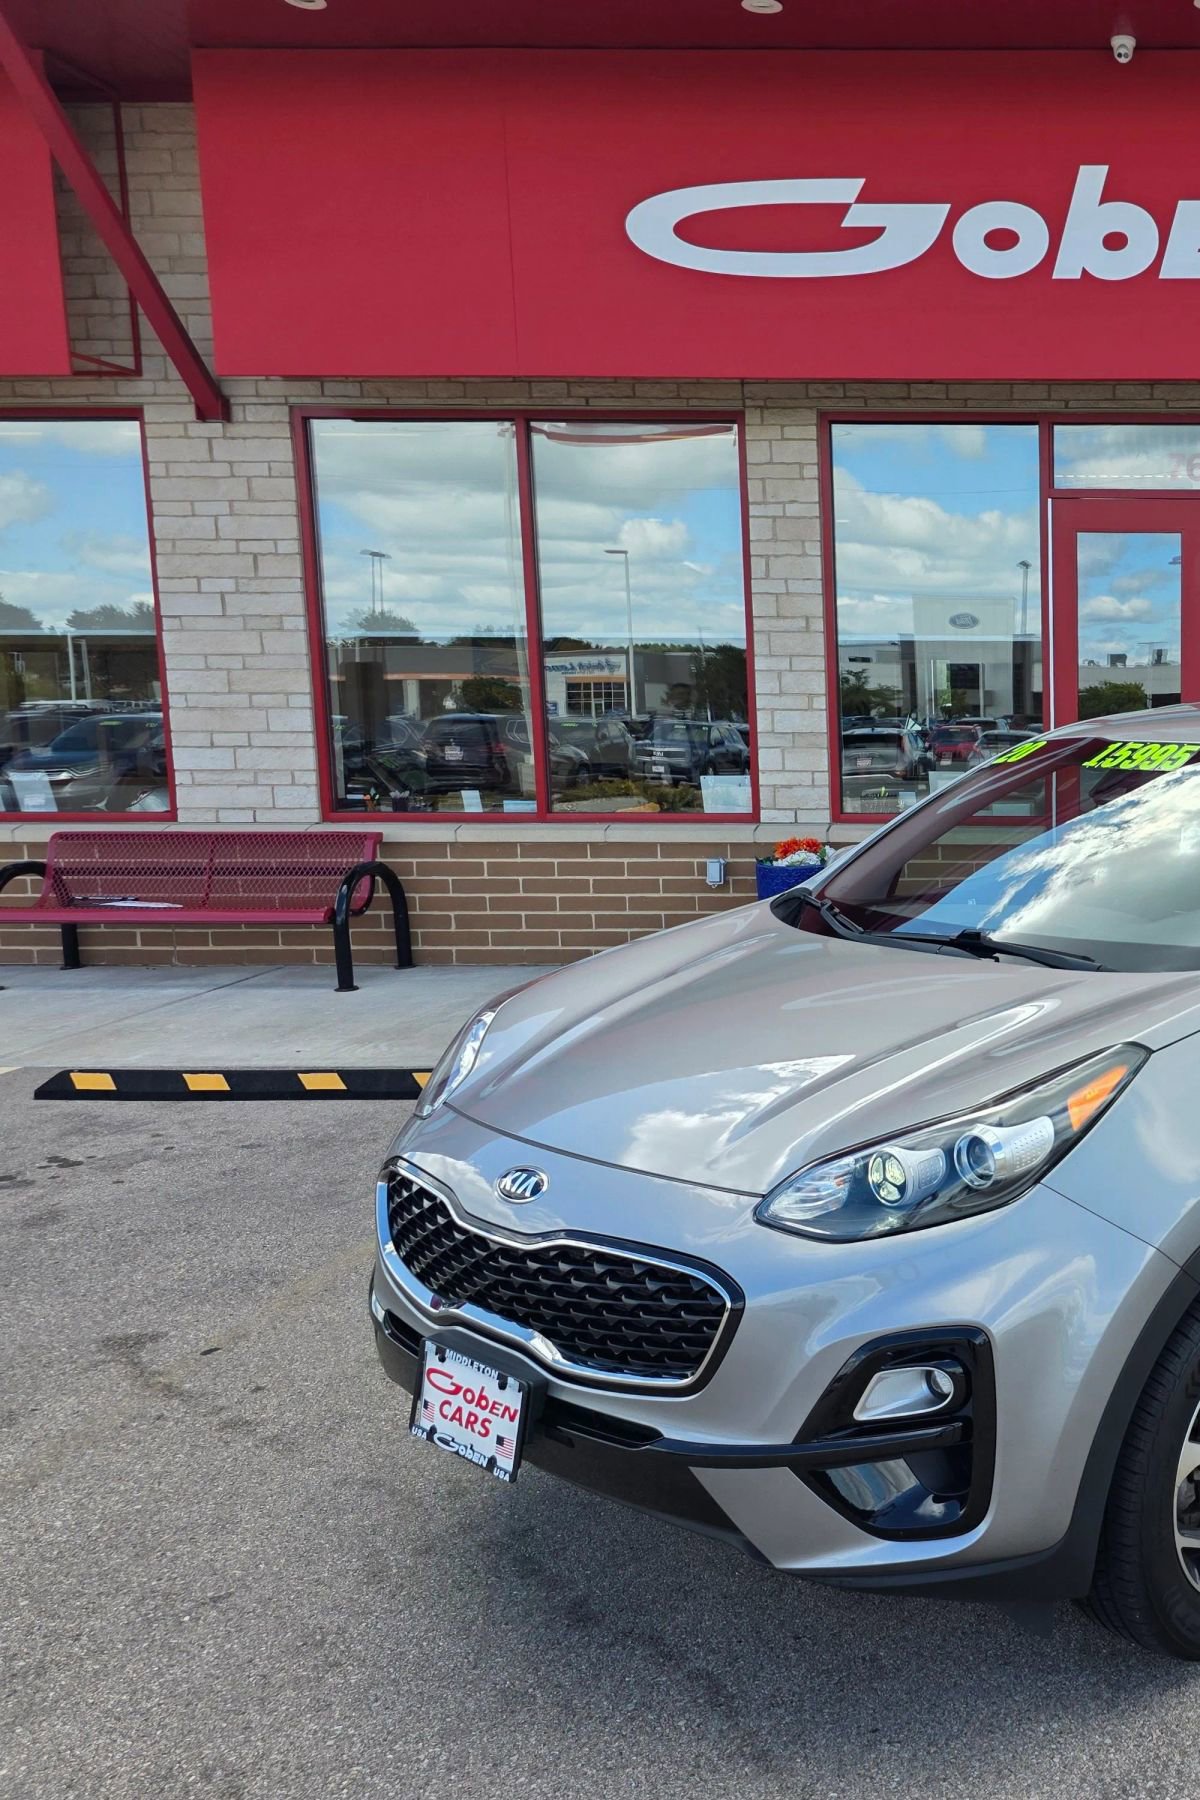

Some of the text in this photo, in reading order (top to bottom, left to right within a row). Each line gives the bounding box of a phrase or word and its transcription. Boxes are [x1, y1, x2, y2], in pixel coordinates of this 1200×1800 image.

[499, 1170, 541, 1198] KIA
[445, 1349, 499, 1380] MIDDLETON
[438, 1399, 493, 1438] CARS
[411, 1425, 428, 1441] USA
[493, 1466, 511, 1482] USA
